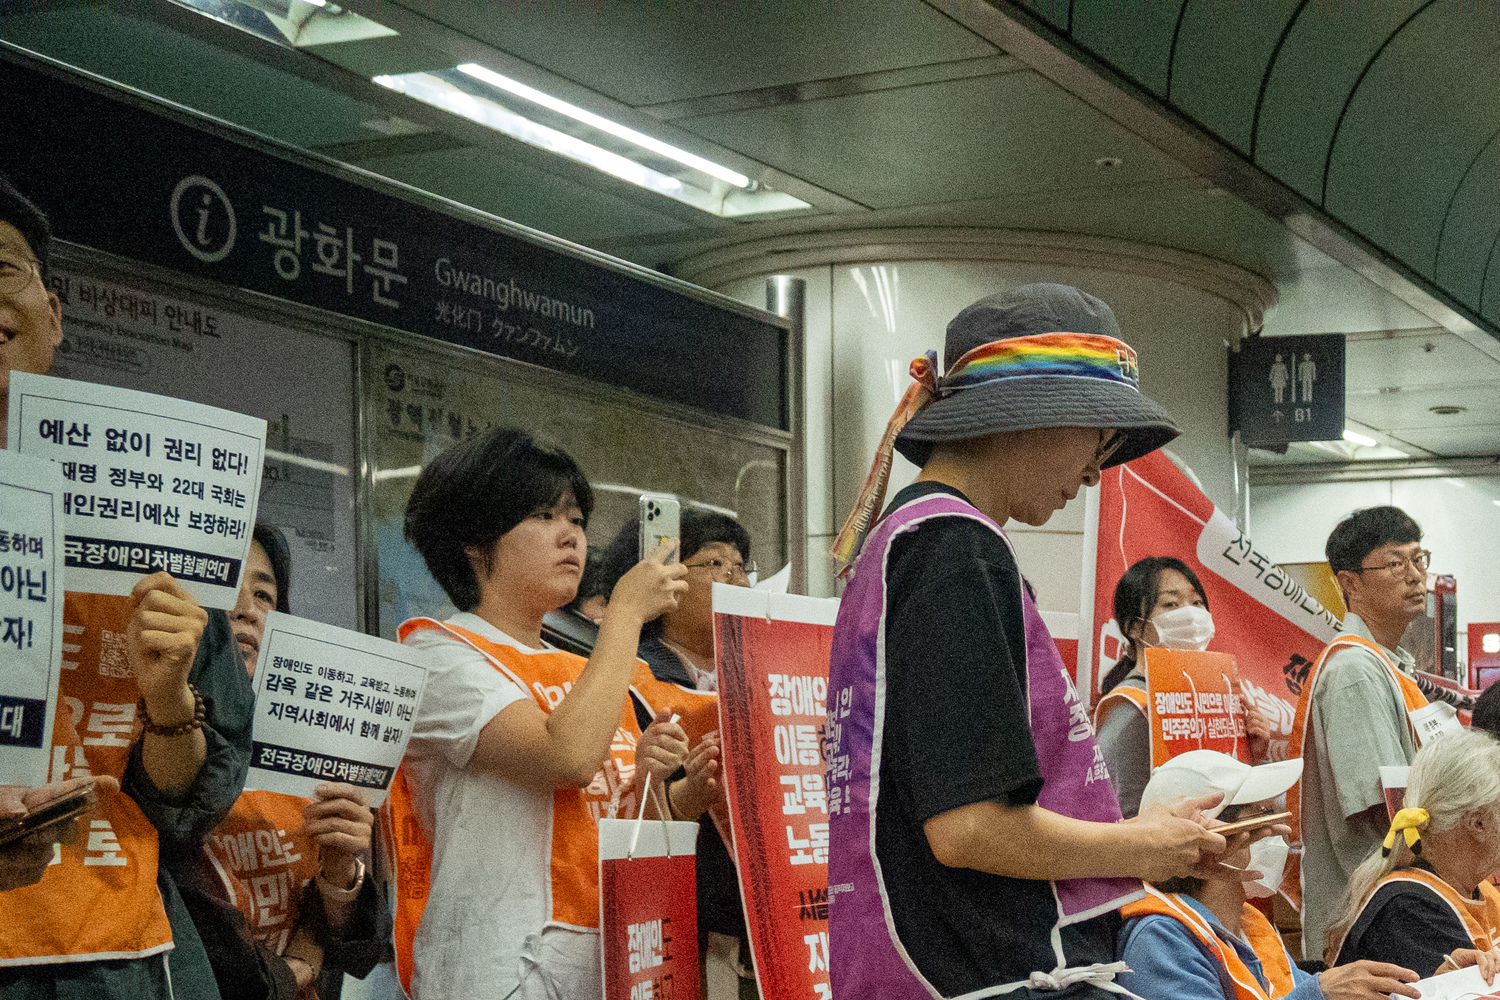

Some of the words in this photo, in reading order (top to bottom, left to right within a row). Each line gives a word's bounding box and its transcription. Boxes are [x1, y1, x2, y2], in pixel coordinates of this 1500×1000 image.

[259, 204, 407, 309] 광화문
[79, 284, 158, 325] 비상대피
[164, 304, 222, 339] 안내도
[435, 257, 595, 328] Gwanghwamun
[1294, 408, 1313, 423] B1
[39, 418, 92, 448] 예산
[105, 427, 151, 457] 없이
[164, 436, 202, 467] 권리
[211, 447, 250, 476] 없다!
[108, 467, 164, 493] 정부와
[172, 478, 205, 501] 22대
[210, 484, 246, 510] 국회는
[188, 510, 247, 541] 보장하라!
[64, 540, 231, 581] 국장애인차별철폐연대
[1, 564, 47, 603] 아닌
[272, 655, 313, 675] 장애인도
[317, 665, 356, 686] 이동하고,
[266, 673, 297, 696] 감옥
[304, 681, 333, 704] 같은
[339, 689, 394, 718] 거주시설이
[396, 703, 415, 722] 아닌
[767, 672, 830, 717] 장애인
[1155, 692, 1193, 715] 장애인도
[267, 701, 355, 735] 지역사회에서
[360, 720, 380, 741] 함께
[383, 725, 403, 745] 살자!
